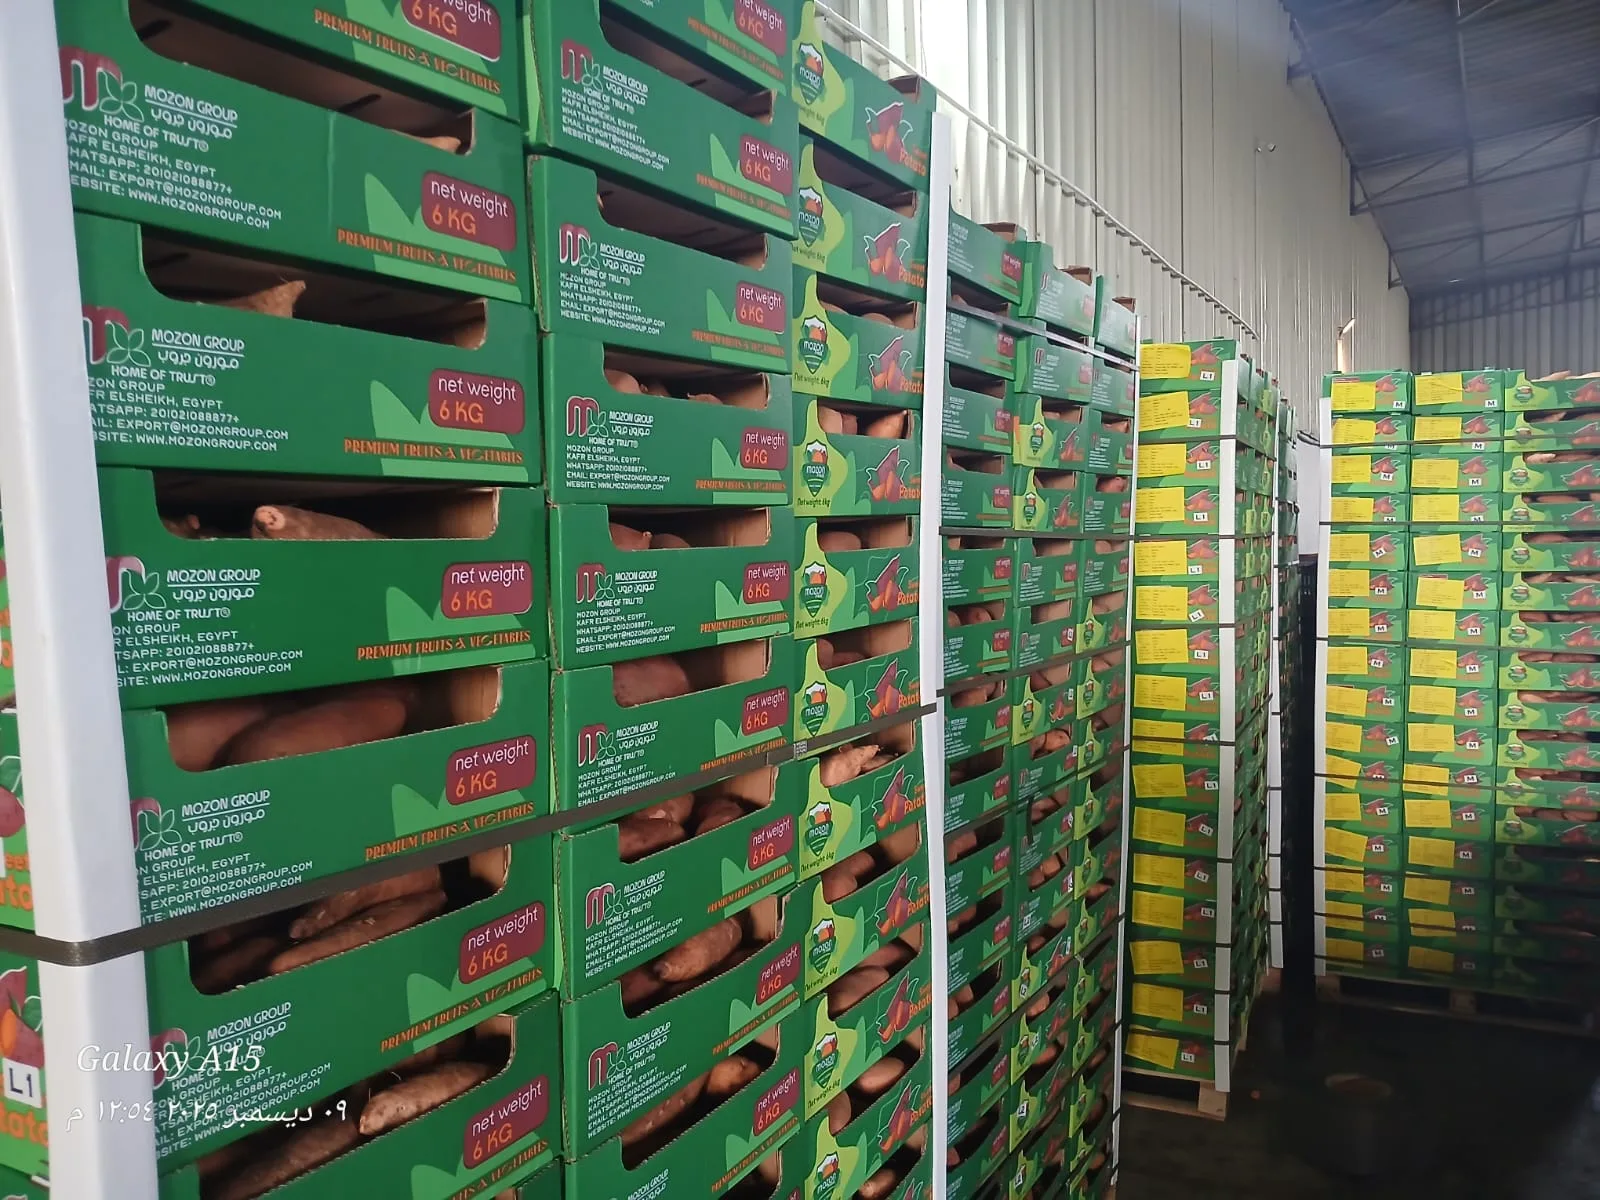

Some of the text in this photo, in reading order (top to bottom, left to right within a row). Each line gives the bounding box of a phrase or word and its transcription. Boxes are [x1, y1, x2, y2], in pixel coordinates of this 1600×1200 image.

[412, 0, 457, 36] 6 KG
[444, 0, 491, 25] eight
[145, 84, 238, 125] MOZON GROUP
[105, 114, 140, 133] HOME
[143, 124, 158, 138] OF
[113, 130, 158, 152] GROUP
[68, 133, 216, 178] AFR ELSHEIKH, EGYPT
[70, 147, 232, 196] HATSAPP: 201021088877+
[69, 160, 282, 221] MAIL: EXPORT@MOZONGROUP.COM
[432, 182, 507, 216] net weight
[71, 175, 270, 231] EBSITE: WWW.MOZONGROUP.COM
[432, 204, 475, 233] 6 KG
[152, 328, 245, 353] MOZON GROUP
[112, 365, 147, 378] HOME
[150, 369, 165, 380] OF
[88, 377, 165, 393] ZON GROUP
[440, 376, 515, 402] net weight
[111, 390, 178, 407] ELSHEIKH,
[182, 398, 223, 410] EGYPT
[440, 399, 482, 422] 6 KG
[91, 405, 239, 425] ATSAPP: 201021088877+
[117, 419, 289, 441] EXPORT@MOZONGROUP.COM
[747, 432, 785, 449] net weight
[137, 434, 277, 452] WWW.MOZONGROUP.COM
[745, 448, 767, 463] 6 KG
[900, 486, 920, 498] Potat
[167, 569, 260, 582] MOZON GROUP
[452, 564, 524, 587] net weight
[749, 563, 786, 580] net weight
[451, 589, 492, 611] 6 KG
[748, 582, 769, 598] 6 KG
[128, 610, 162, 622] HOME
[165, 609, 181, 619] OF
[126, 635, 194, 646] ELSHEIKH,
[198, 631, 238, 641] EGYPT
[135, 623, 180, 633] GROUP
[115, 643, 254, 660] TSAPP: 201021088877+
[133, 651, 303, 672] EXPORT@MOZONGROUP.COM
[152, 664, 291, 683] WWW.MOZONGROUP.COM
[455, 739, 526, 770] net weight
[455, 769, 496, 797] 6 KG
[182, 789, 271, 817] MOZON GROUP
[145, 846, 178, 862] HOME
[181, 841, 196, 854] OF
[144, 864, 208, 886] ELSHEIKH,
[212, 853, 250, 869] EGYPT
[153, 855, 195, 872] GROUP
[151, 861, 313, 910] EXPORT@MOZONGROUP.COM
[182, 862, 266, 889] 201021088877+
[170, 876, 302, 918] WWW.MOZONGROUP.COM
[468, 907, 538, 951] net weight
[467, 943, 508, 976] 6 KG
[9, 1068, 33, 1097] L1
